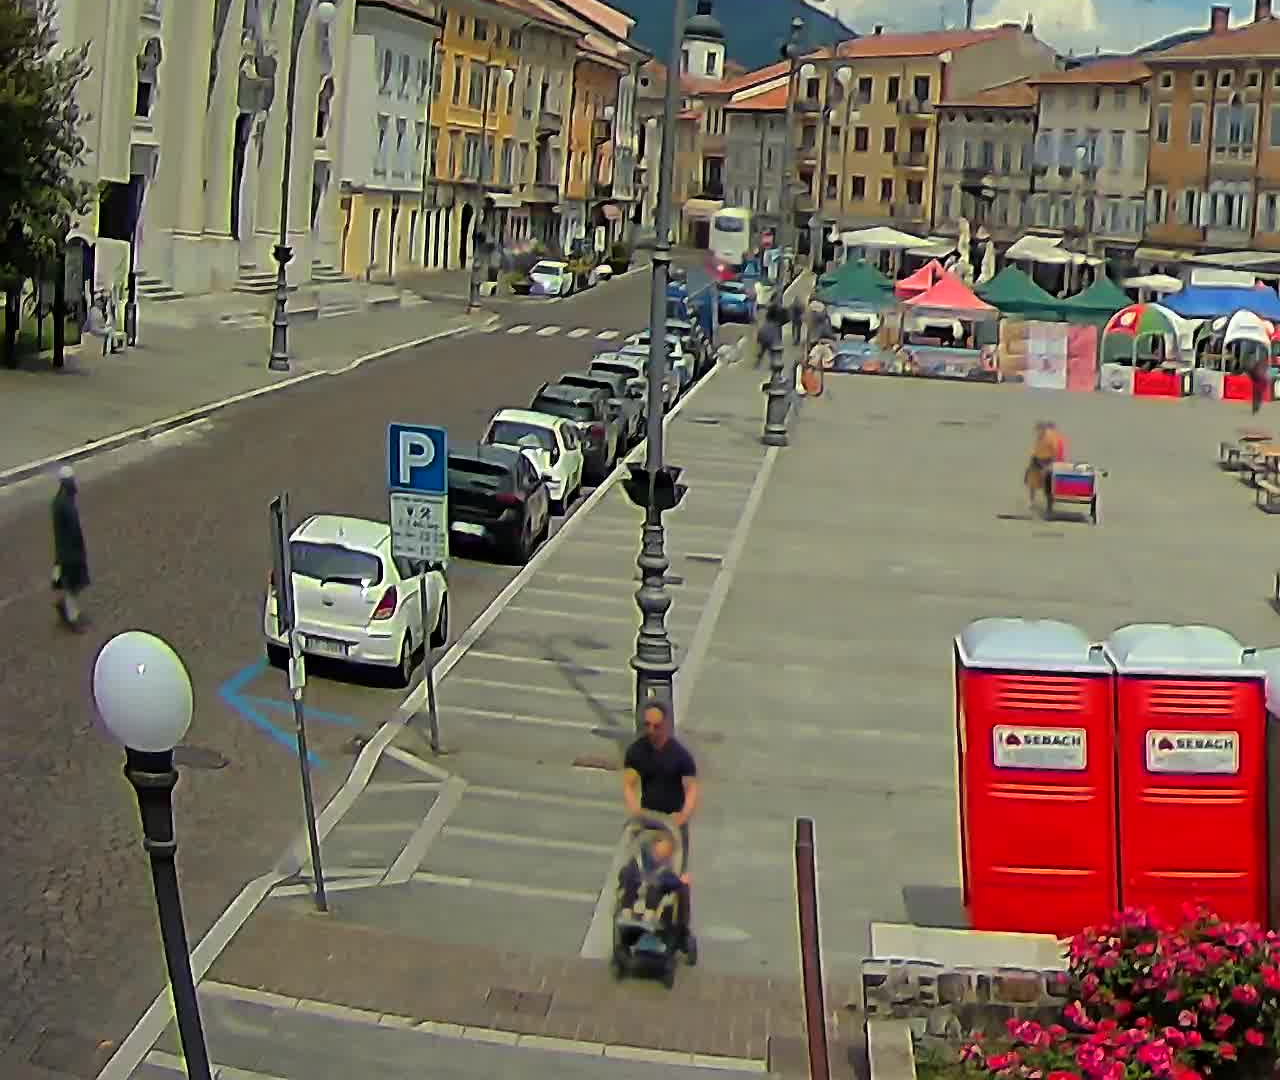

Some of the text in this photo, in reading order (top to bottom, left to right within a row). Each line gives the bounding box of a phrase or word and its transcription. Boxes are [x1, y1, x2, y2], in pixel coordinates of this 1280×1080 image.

[399, 431, 435, 483] P
[1023, 734, 1081, 745] SEBACH
[1175, 738, 1233, 749] SEBACH
